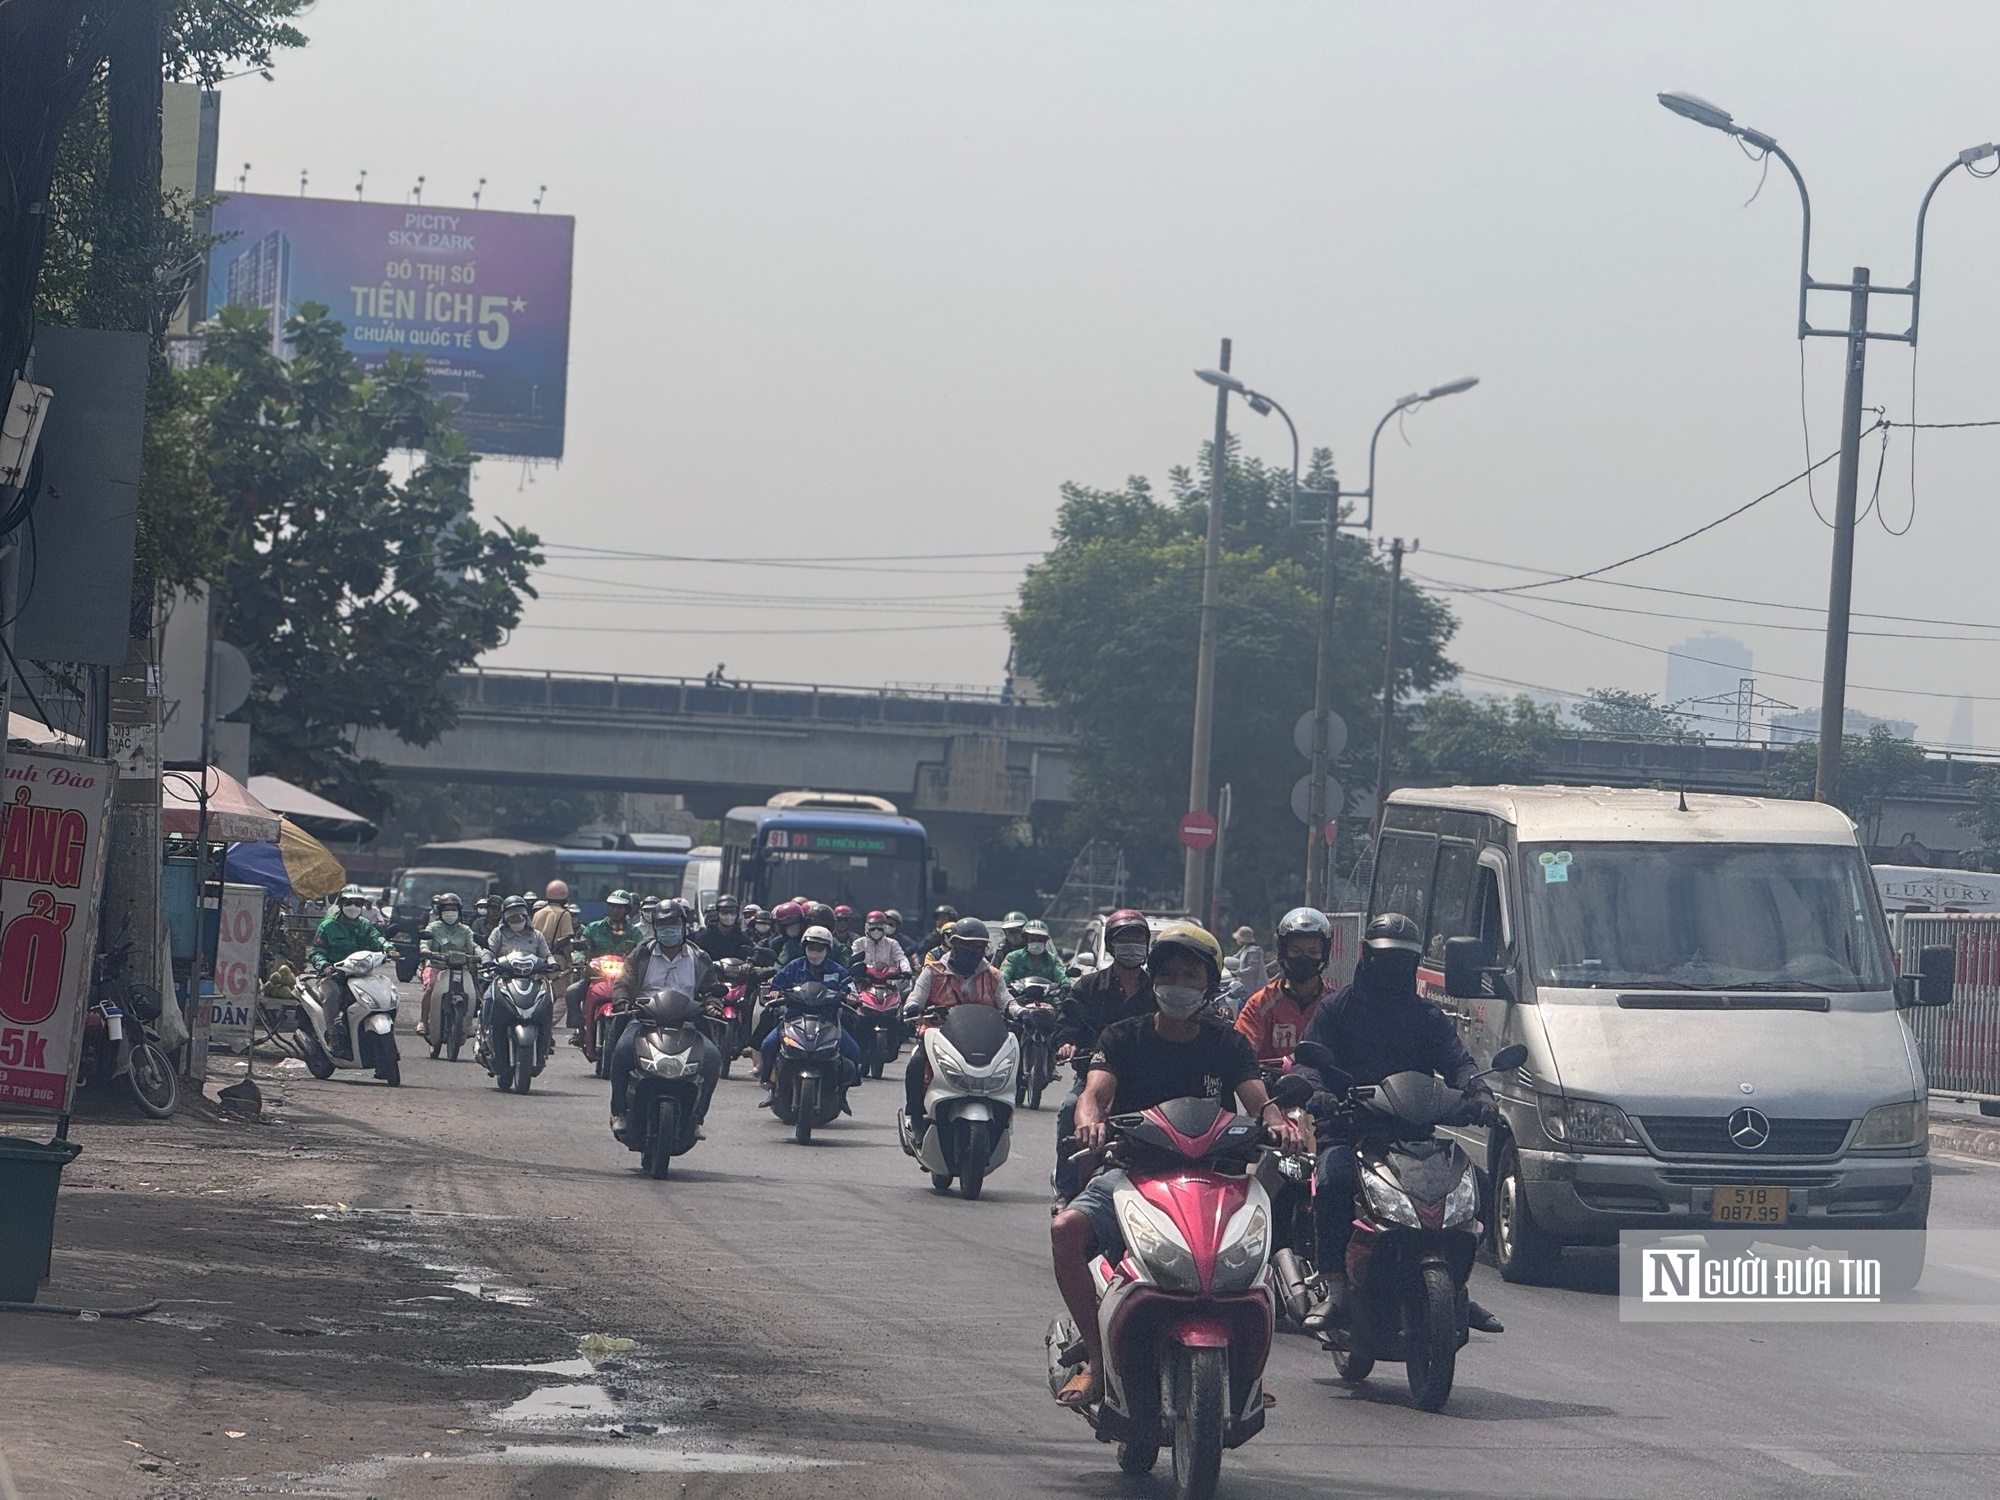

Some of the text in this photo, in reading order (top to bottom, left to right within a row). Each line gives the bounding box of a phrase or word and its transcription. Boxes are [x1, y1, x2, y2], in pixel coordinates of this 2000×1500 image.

[405, 213, 460, 231] PICITY
[388, 230, 475, 250] SKY PARK
[385, 258, 476, 286] ĐÔ THỊ SỐ
[350, 280, 510, 350] TIỆN ÍCH 5
[354, 322, 474, 348] CHUẨN QUỐC TẾ
[424, 366, 462, 377] YUNDAI
[46, 766, 95, 789] Đào
[0, 785, 88, 889] ẢNG
[771, 830, 785, 846] 91
[1885, 882, 1993, 902] LUXURY
[211, 1001, 249, 1026] DÂN
[1720, 1205, 1779, 1221] 087.95
